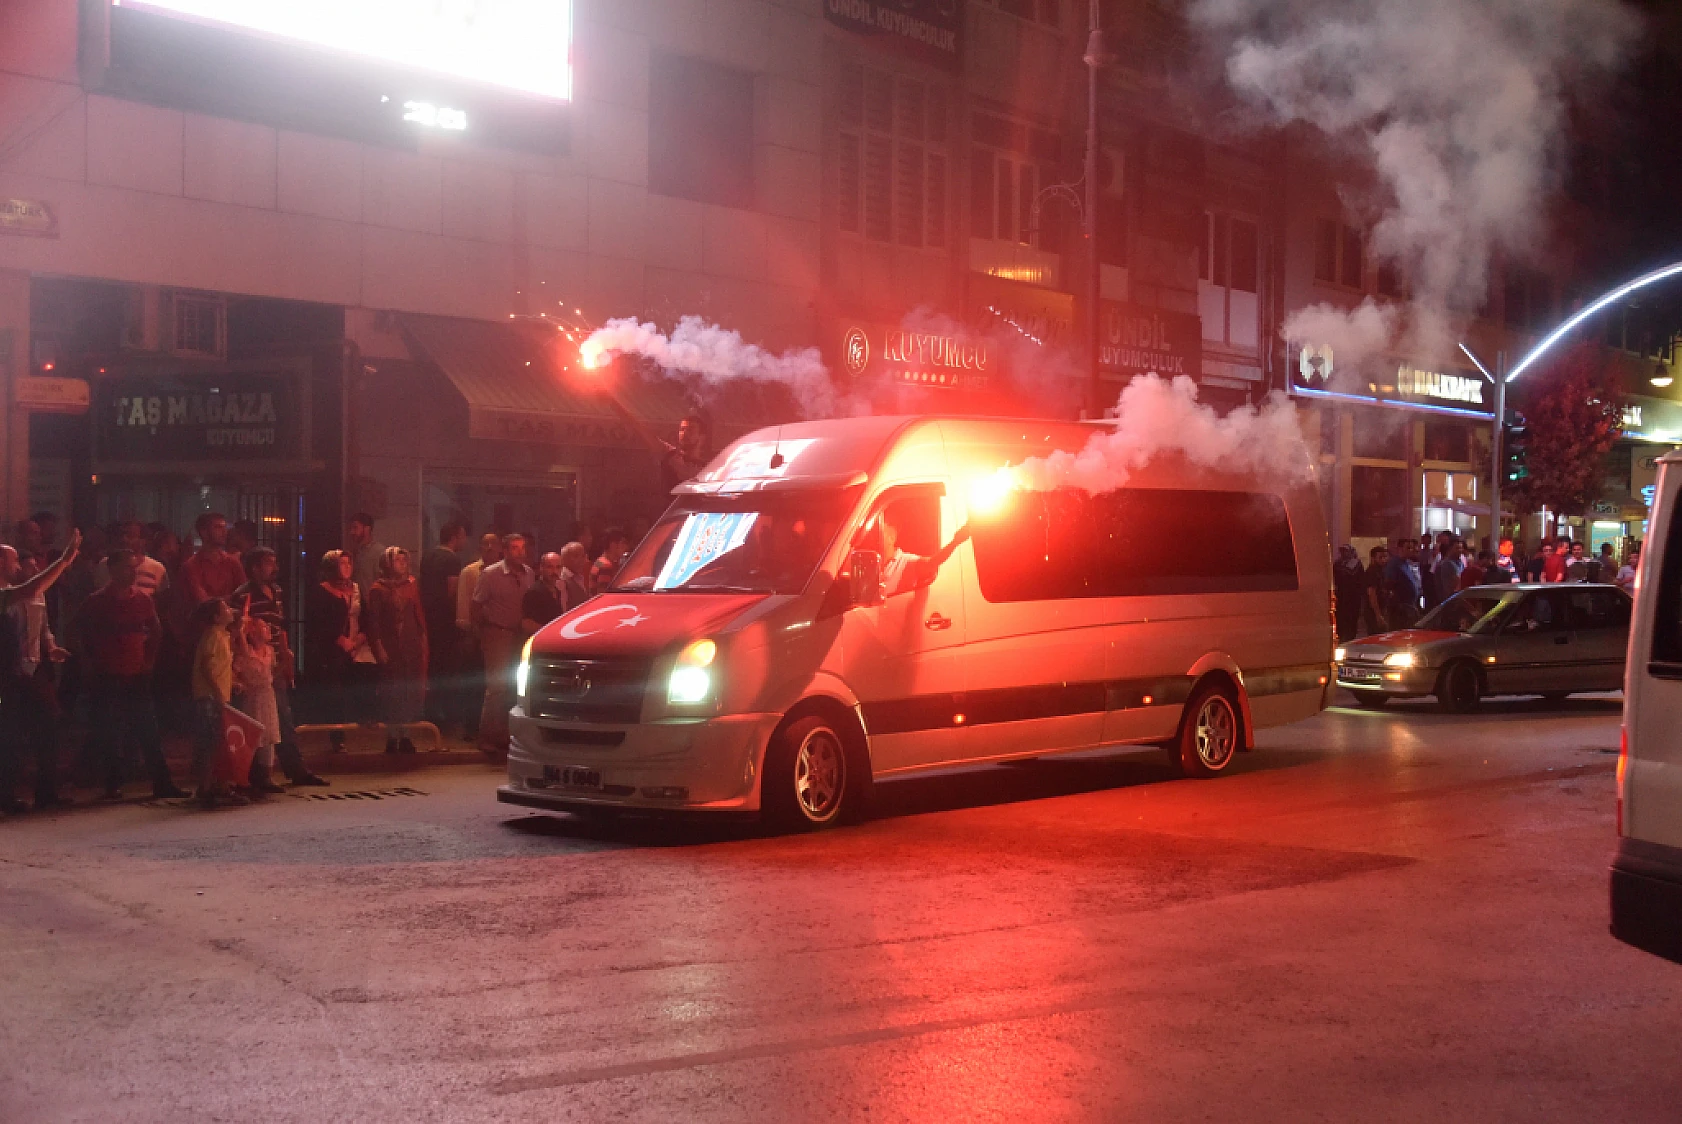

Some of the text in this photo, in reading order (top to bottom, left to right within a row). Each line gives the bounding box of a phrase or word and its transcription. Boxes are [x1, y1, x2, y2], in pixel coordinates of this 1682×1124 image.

[876, 4, 956, 53] KUYUMCULUK
[1107, 306, 1172, 351] ÜNDİL
[883, 329, 987, 371] KUYUMCU
[115, 396, 162, 435] TAŞ
[206, 428, 276, 445] KUYUMCU
